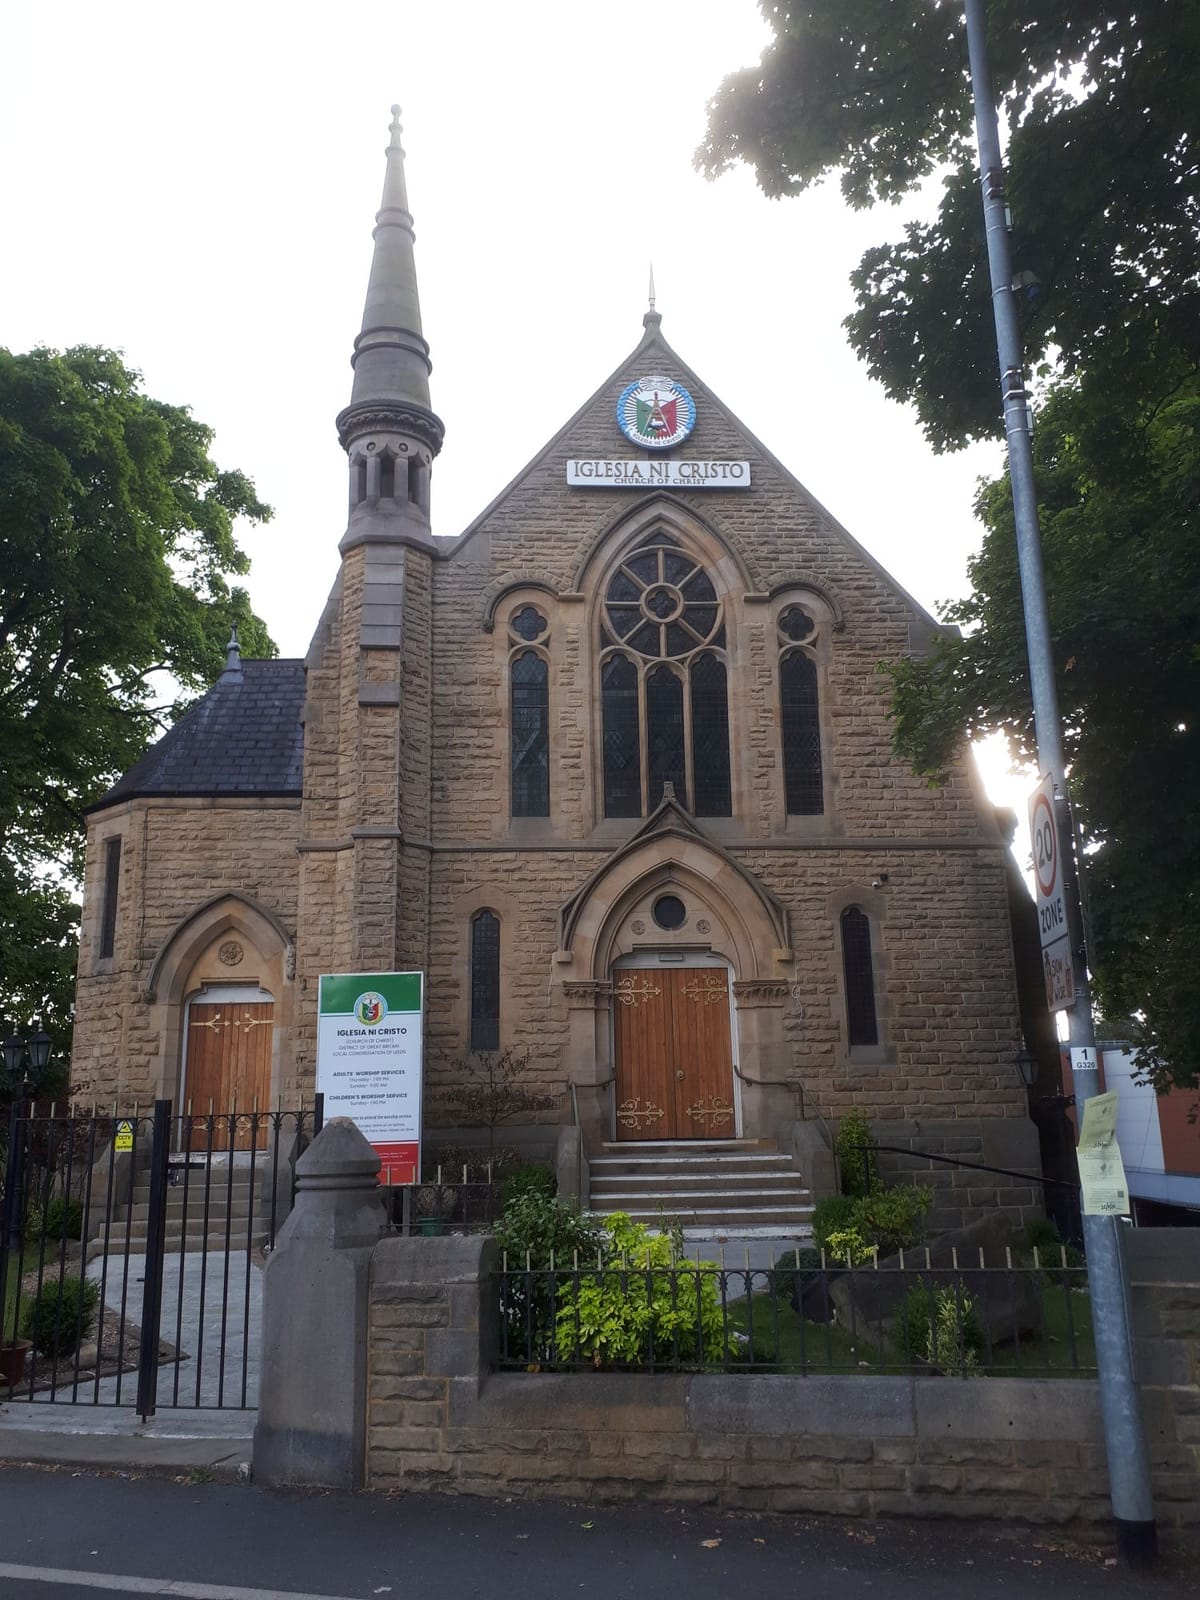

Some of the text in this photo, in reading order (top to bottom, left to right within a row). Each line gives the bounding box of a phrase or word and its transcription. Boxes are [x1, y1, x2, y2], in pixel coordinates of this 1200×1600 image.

[574, 462, 744, 479] IGLESIA NI CRISTO
[1036, 820, 1053, 869] 20
[1040, 897, 1064, 934] ZONE
[337, 1029, 366, 1037] IGLESIA
[378, 1027, 408, 1035] CRISTO
[1081, 1048, 1088, 1060] 1
